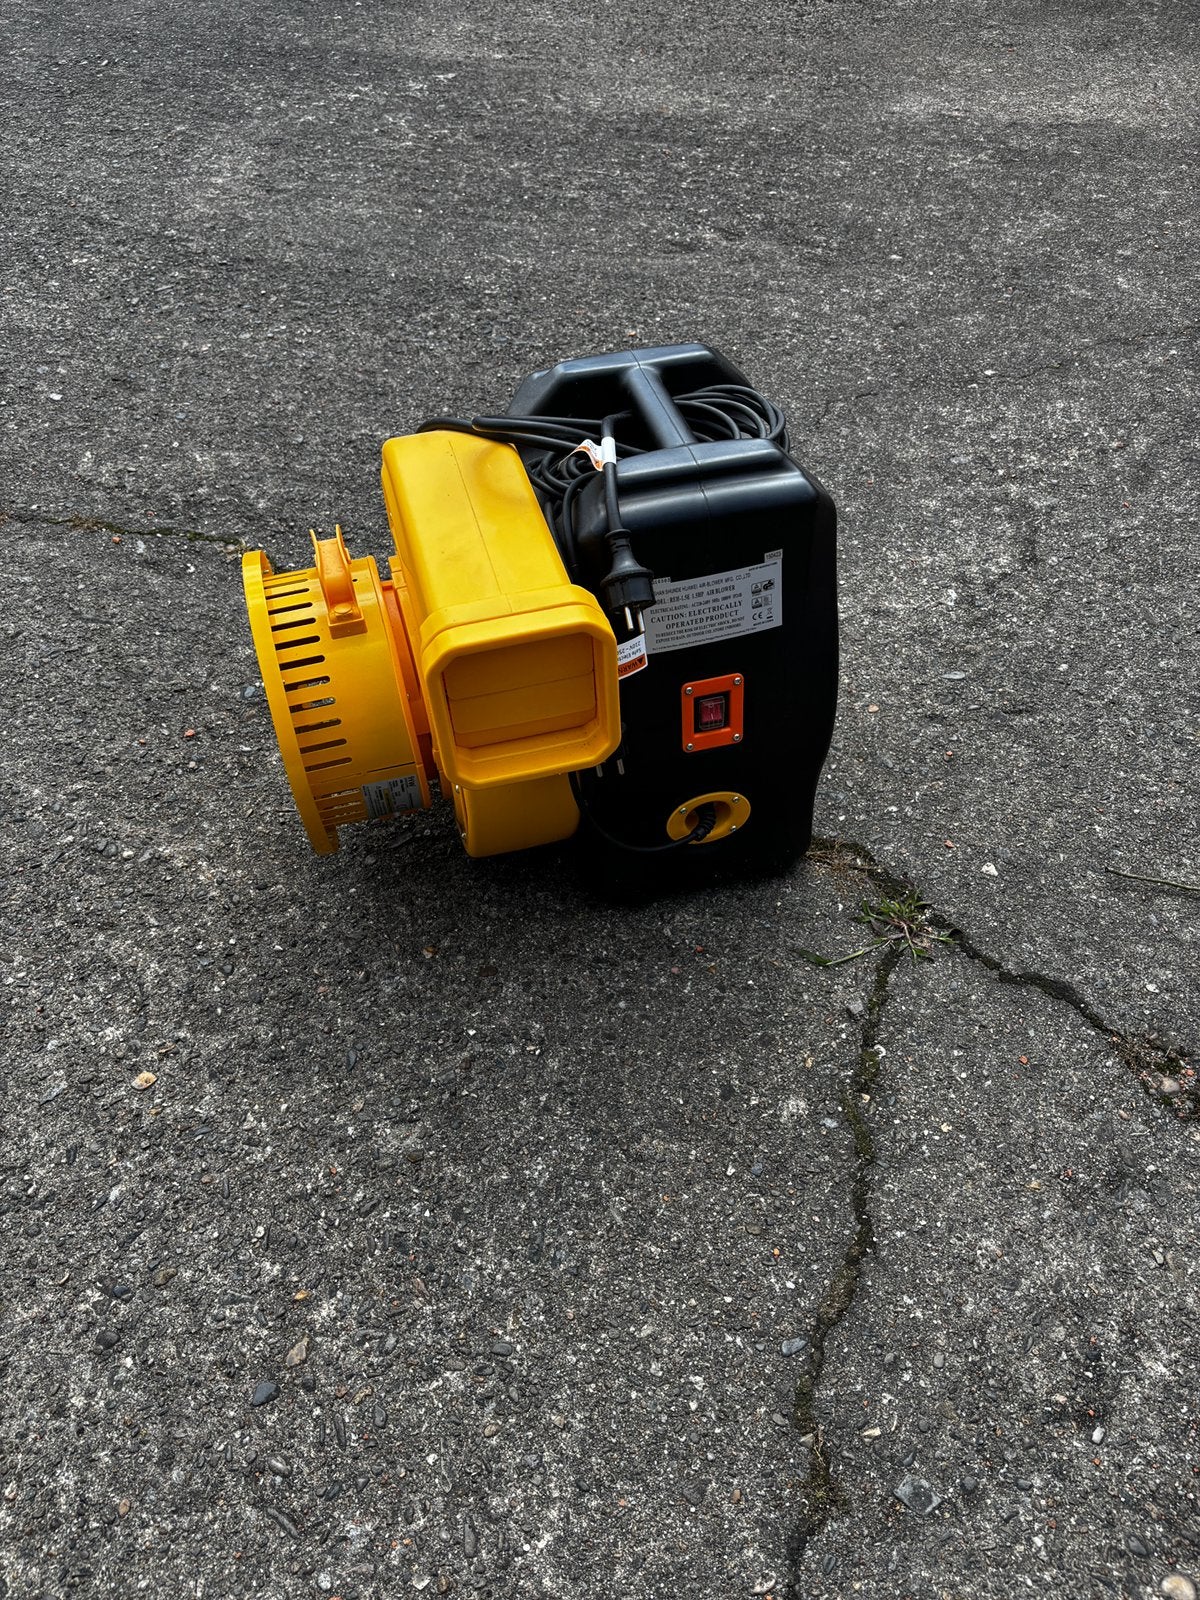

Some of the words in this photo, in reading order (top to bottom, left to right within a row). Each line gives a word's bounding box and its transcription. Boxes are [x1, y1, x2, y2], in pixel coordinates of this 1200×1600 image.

[715, 584, 735, 594] BLOWER
[651, 612, 688, 624] CAUTION:
[688, 600, 743, 617] ELECTRICALLY
[665, 616, 704, 630] OPERATED
[705, 610, 739, 622] PRODUCT
